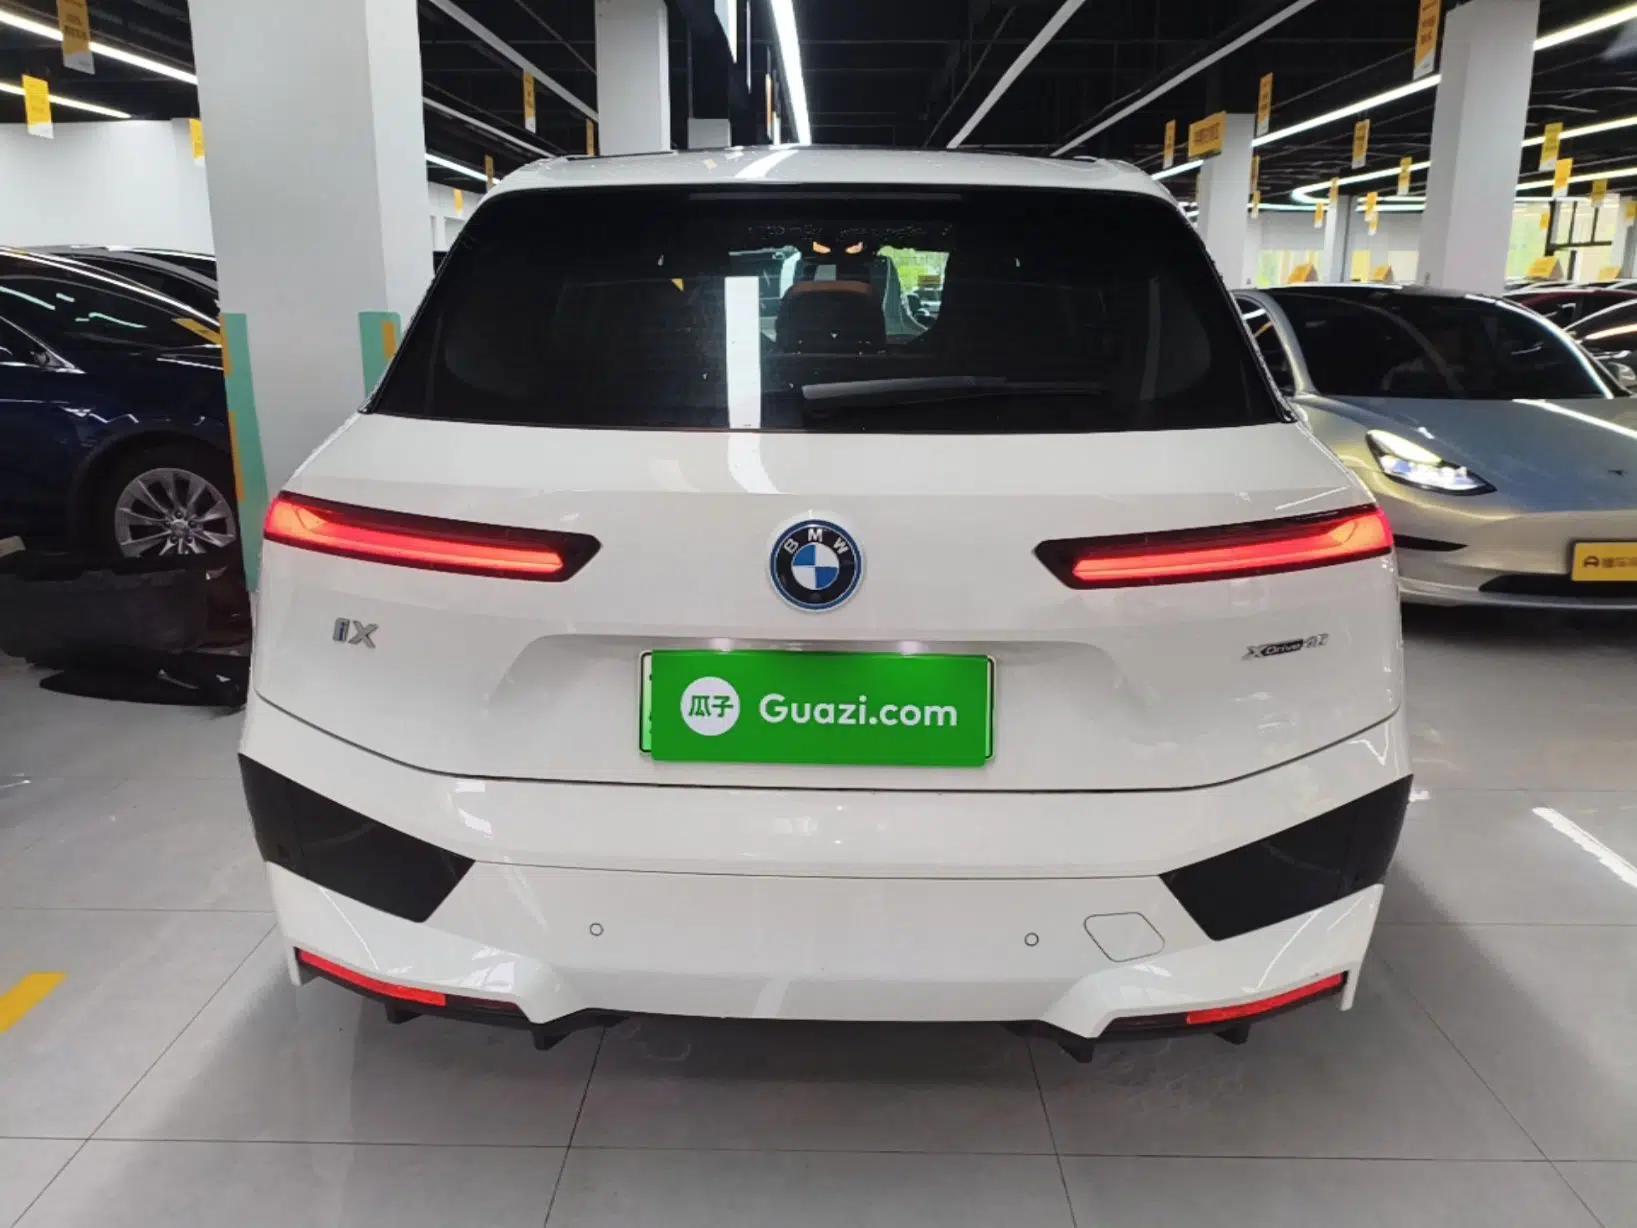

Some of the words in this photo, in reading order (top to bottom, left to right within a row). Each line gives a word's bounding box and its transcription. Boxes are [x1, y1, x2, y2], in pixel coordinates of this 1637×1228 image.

[783, 528, 849, 555] BMW
[688, 695, 734, 718] 瓜子
[759, 692, 958, 727] Guazi.com
